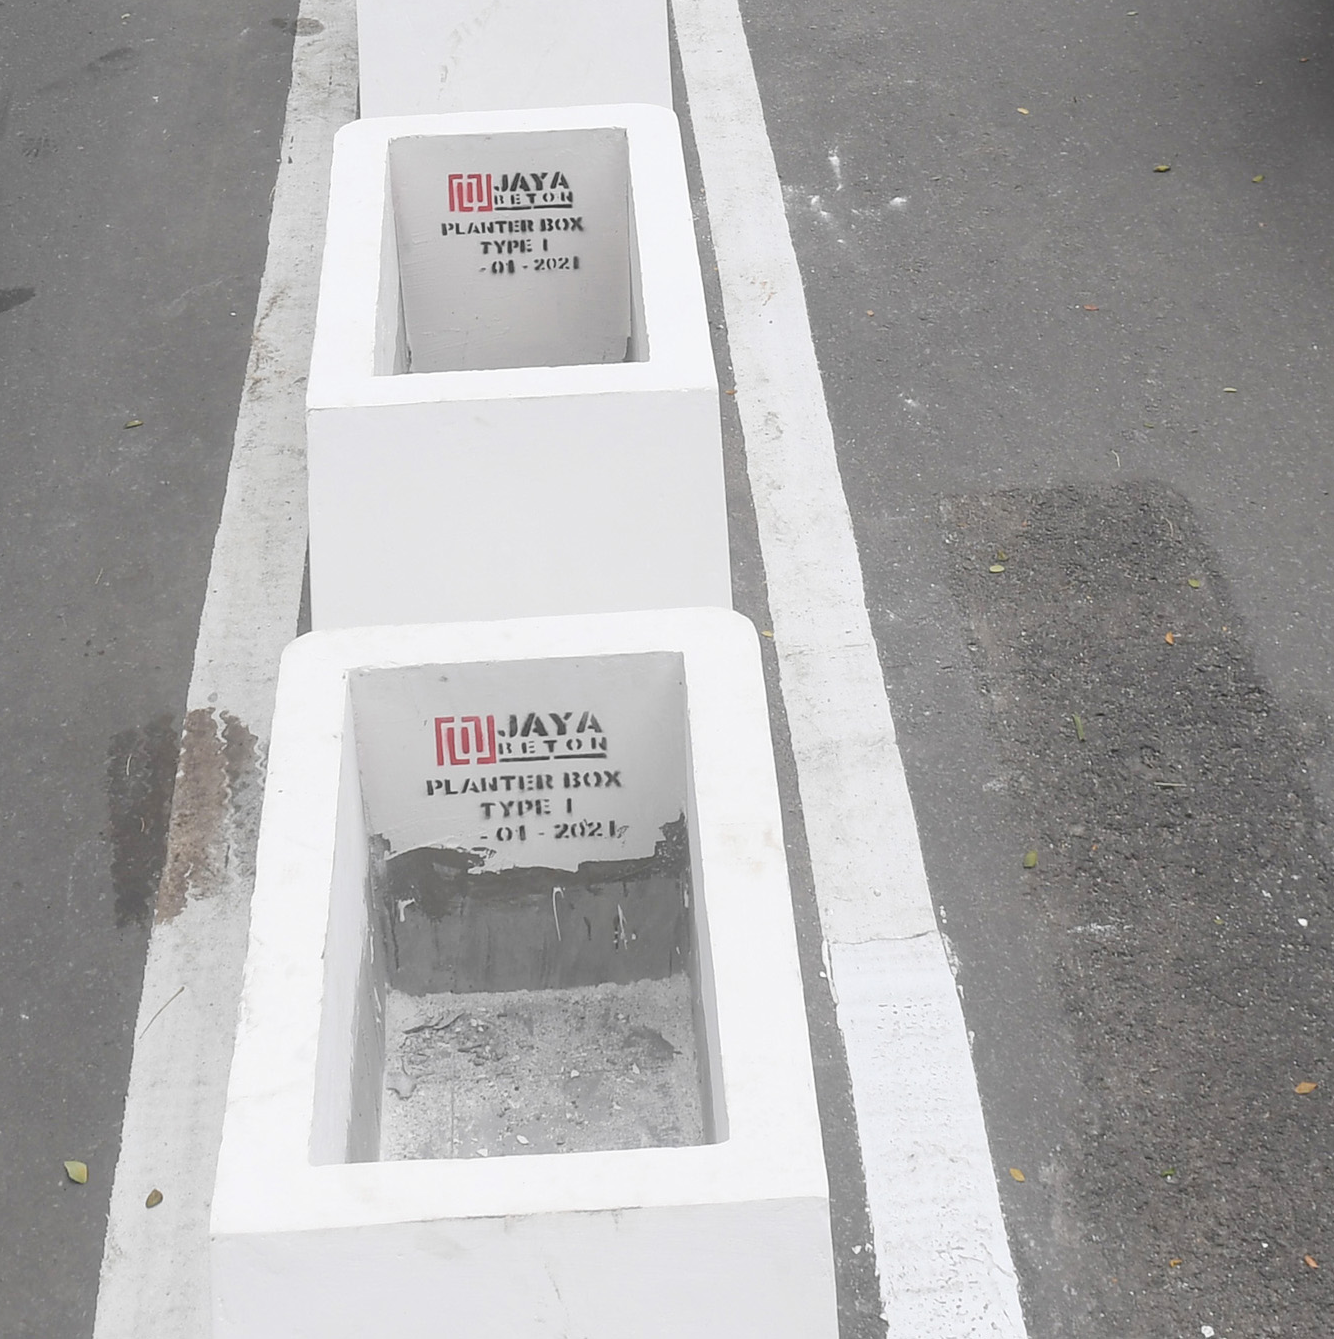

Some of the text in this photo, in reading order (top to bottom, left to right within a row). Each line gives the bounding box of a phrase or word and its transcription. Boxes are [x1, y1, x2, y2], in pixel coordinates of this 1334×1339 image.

[494, 171, 569, 192] JAYA
[494, 191, 573, 205] BETON
[441, 217, 584, 236] PLANTER BOX
[480, 239, 533, 254] TYPE
[497, 711, 604, 738] JAYA
[498, 737, 607, 755] BETON
[426, 770, 622, 796] PLANTER BOX
[480, 799, 551, 819] TYPE
